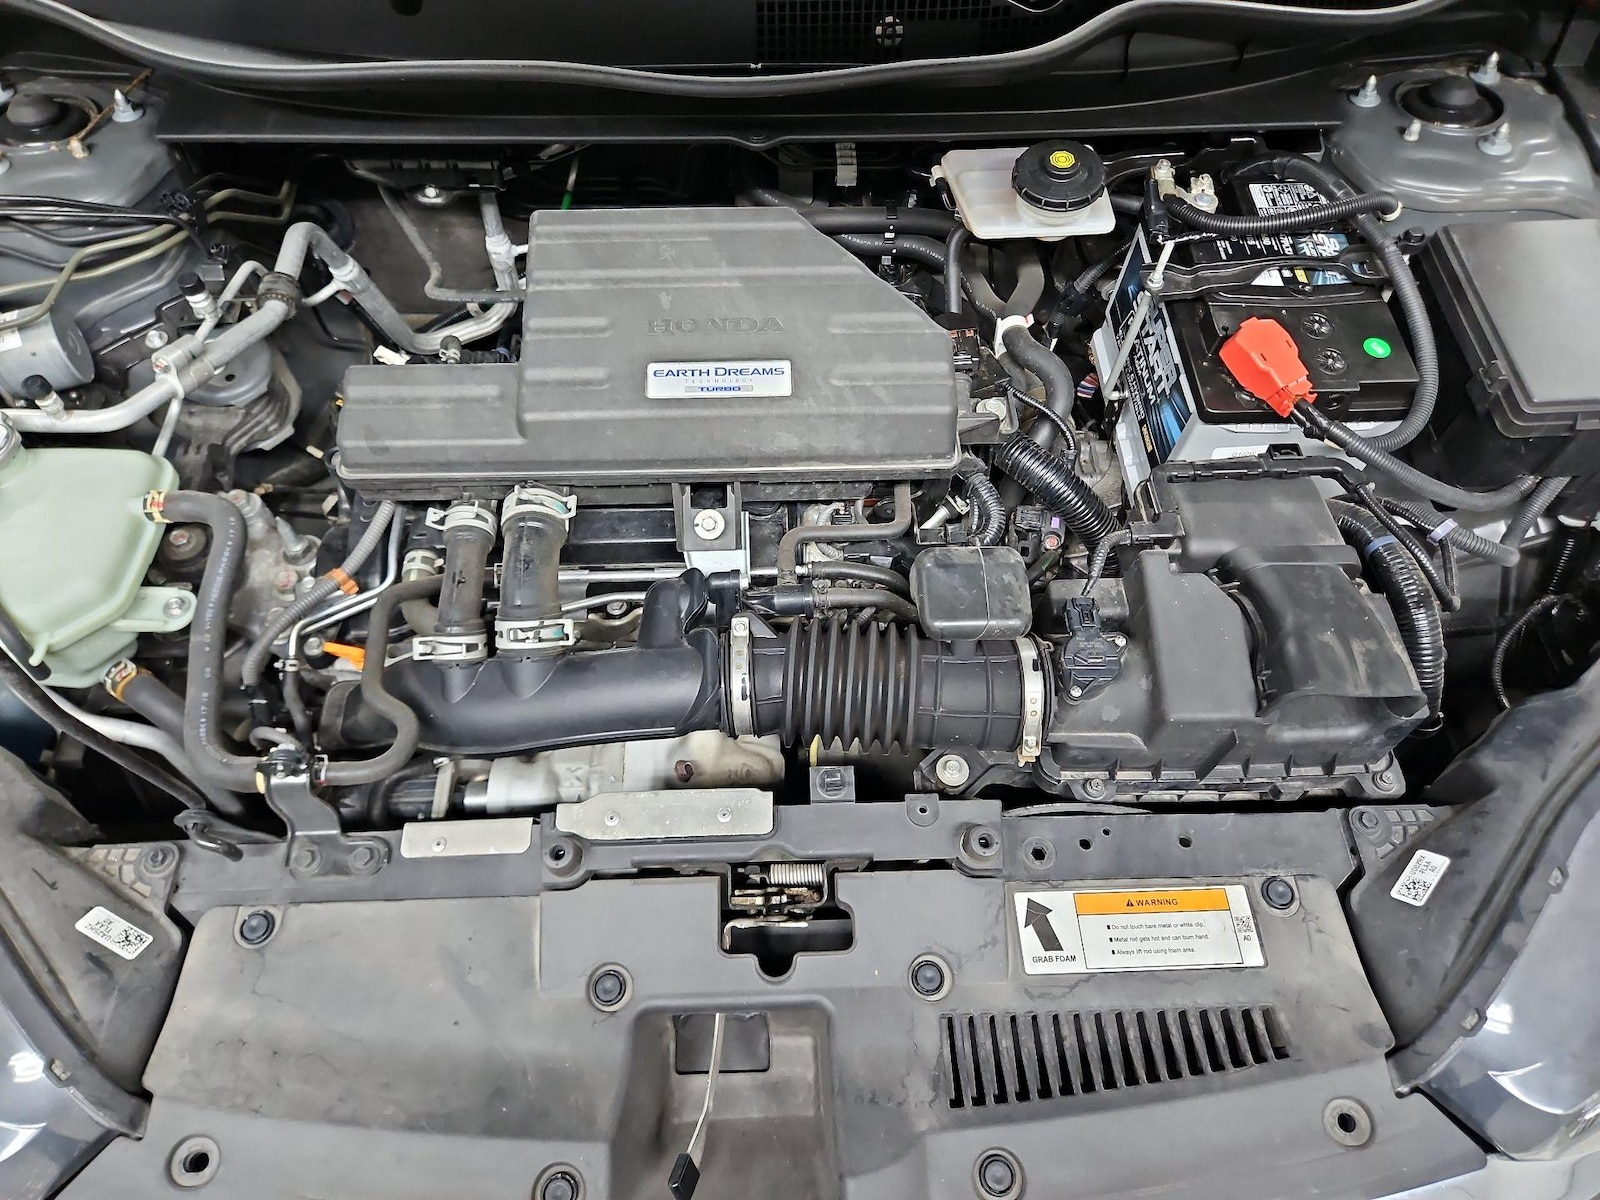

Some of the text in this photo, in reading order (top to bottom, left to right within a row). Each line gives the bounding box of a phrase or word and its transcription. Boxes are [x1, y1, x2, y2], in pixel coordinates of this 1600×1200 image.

[647, 315, 786, 336] HONDA
[1128, 315, 1156, 405] PATINUM
[653, 367, 785, 378] EARTH DREAMS
[1136, 898, 1178, 906] WARNING
[1032, 954, 1077, 963] GRAB FOAM
